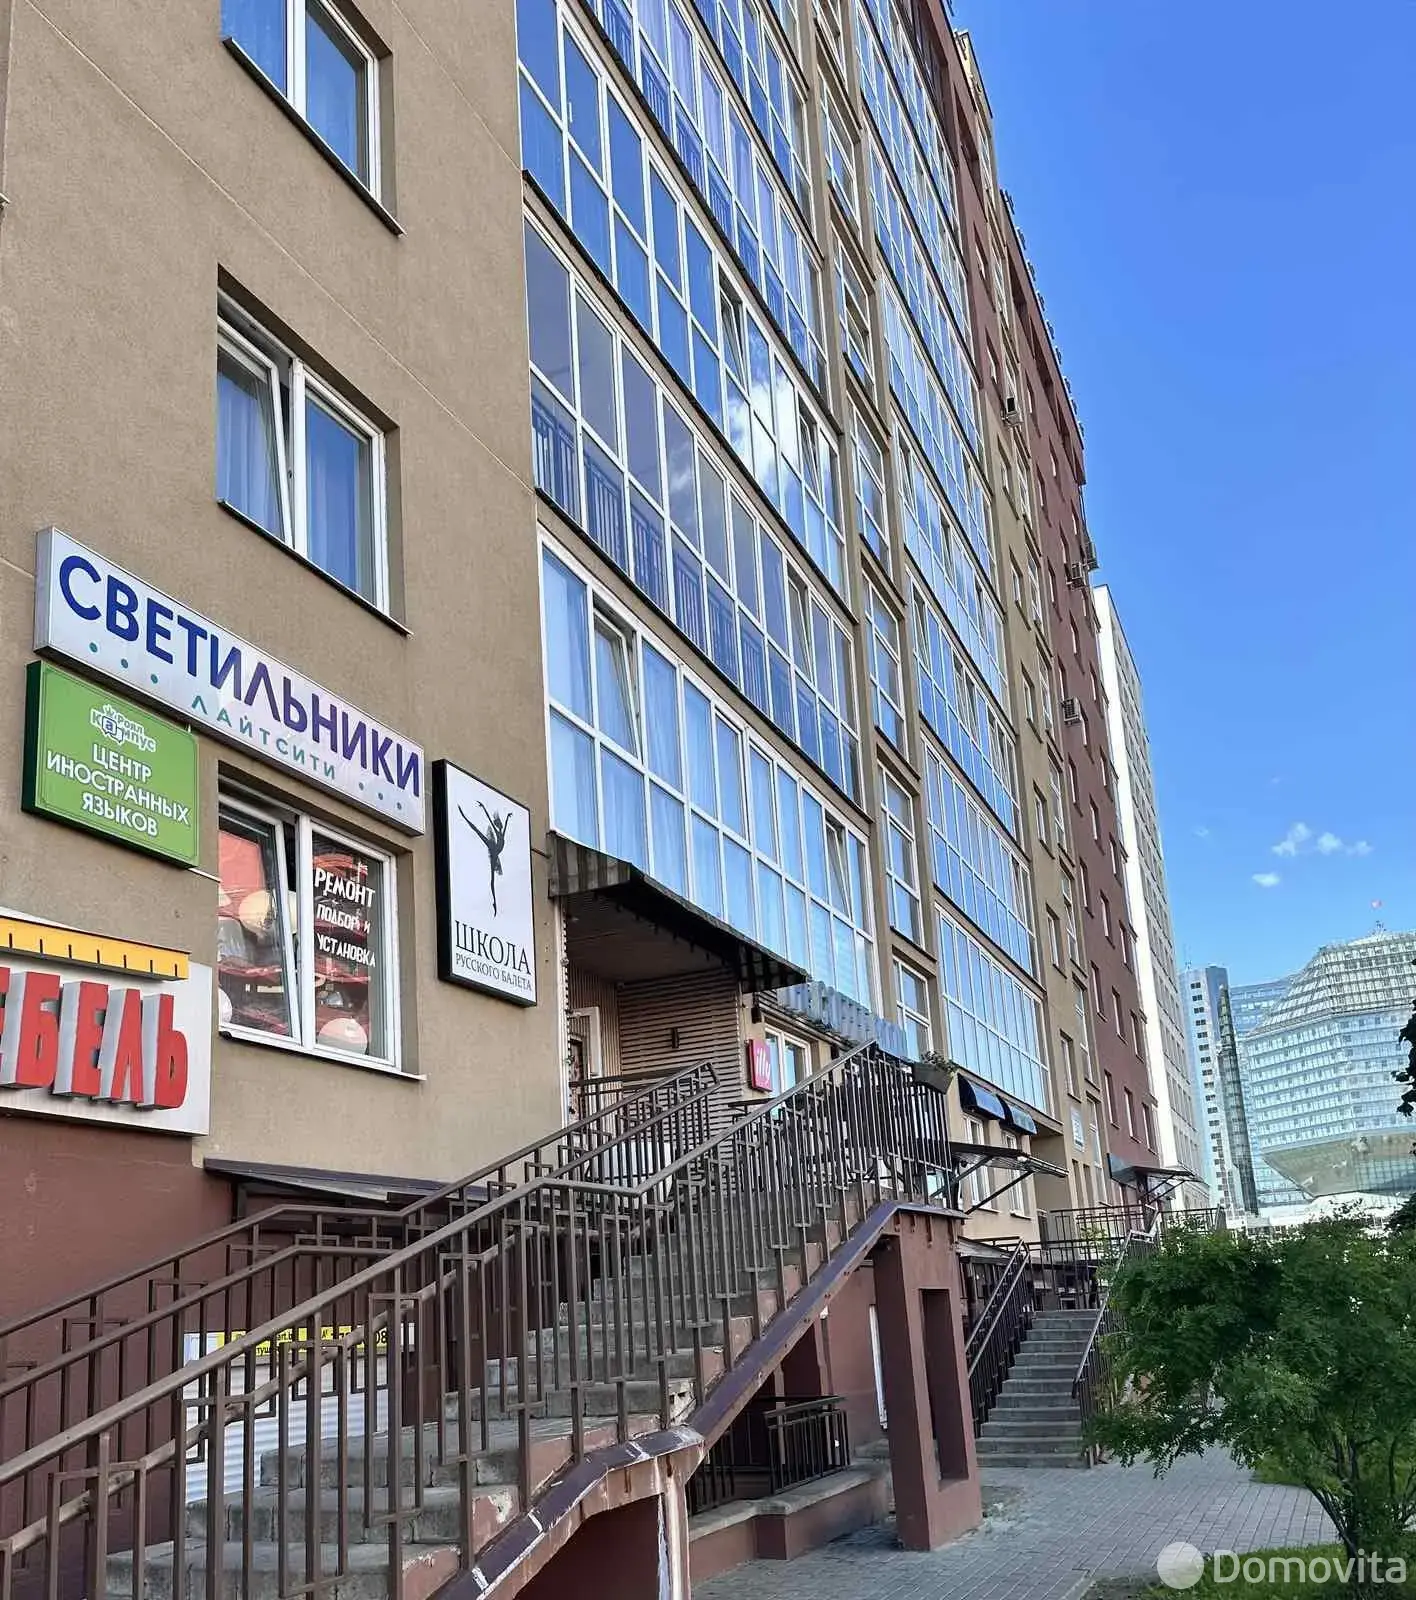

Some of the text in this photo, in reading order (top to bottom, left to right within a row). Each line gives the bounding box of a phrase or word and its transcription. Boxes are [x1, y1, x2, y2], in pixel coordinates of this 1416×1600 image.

[59, 555, 420, 798] СВЕТИЛЬНИКИ
[191, 695, 336, 780] ЛАЙТСИТИ
[92, 744, 152, 782] ЦЕНТР
[46, 750, 190, 825] ИНОСТРАННЫХ
[82, 792, 158, 836] ЯЗЫКОВ
[314, 868, 376, 908] РЕМОНТ
[316, 933, 376, 967] УСТАНОВКА
[455, 920, 531, 975] ШКОЛА
[455, 953, 532, 992] РУССКОГО БАЛЕТА
